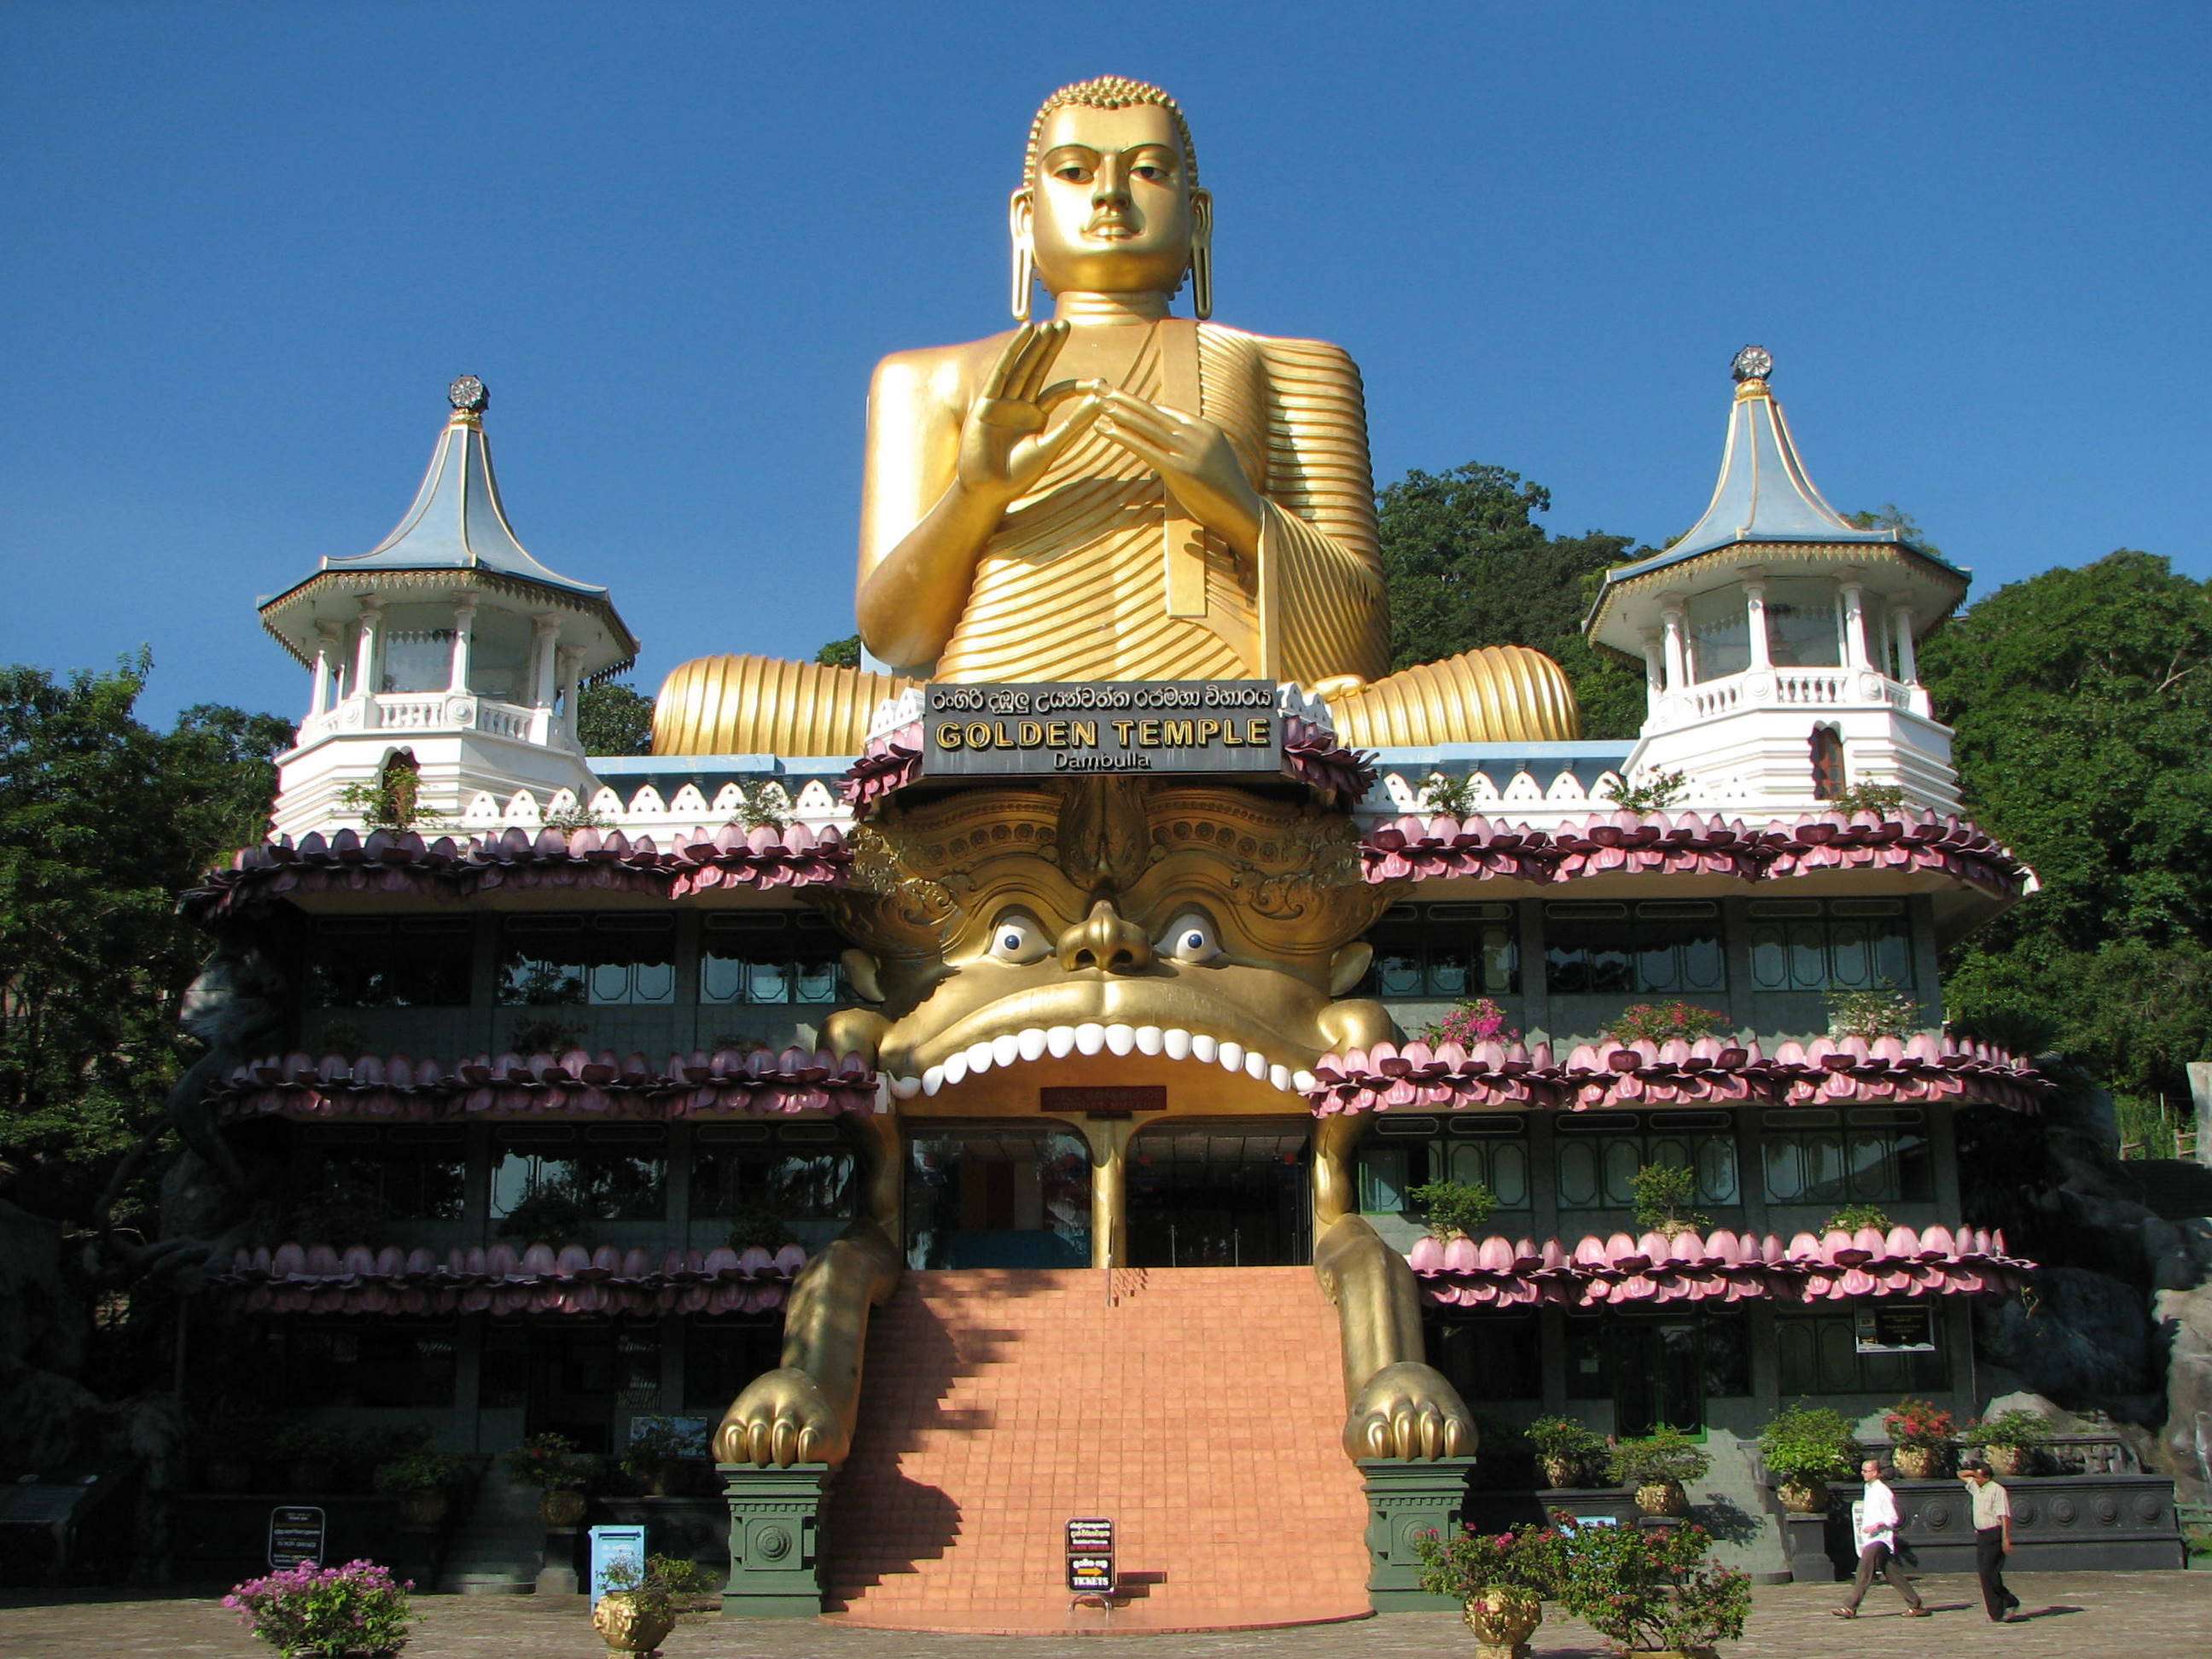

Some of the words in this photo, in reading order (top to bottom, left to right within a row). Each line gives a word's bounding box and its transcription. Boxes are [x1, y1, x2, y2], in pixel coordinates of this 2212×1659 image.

[931, 687, 985, 711] රංගිරි
[1133, 685, 1201, 709] රජමහා
[1204, 684, 1272, 707] විහාරය
[935, 719, 1098, 749] GOLDEN
[1111, 718, 1271, 747] TEMPLE
[1053, 751, 1151, 770] Dambulla
[1072, 1575, 1109, 1586] TICKETS
